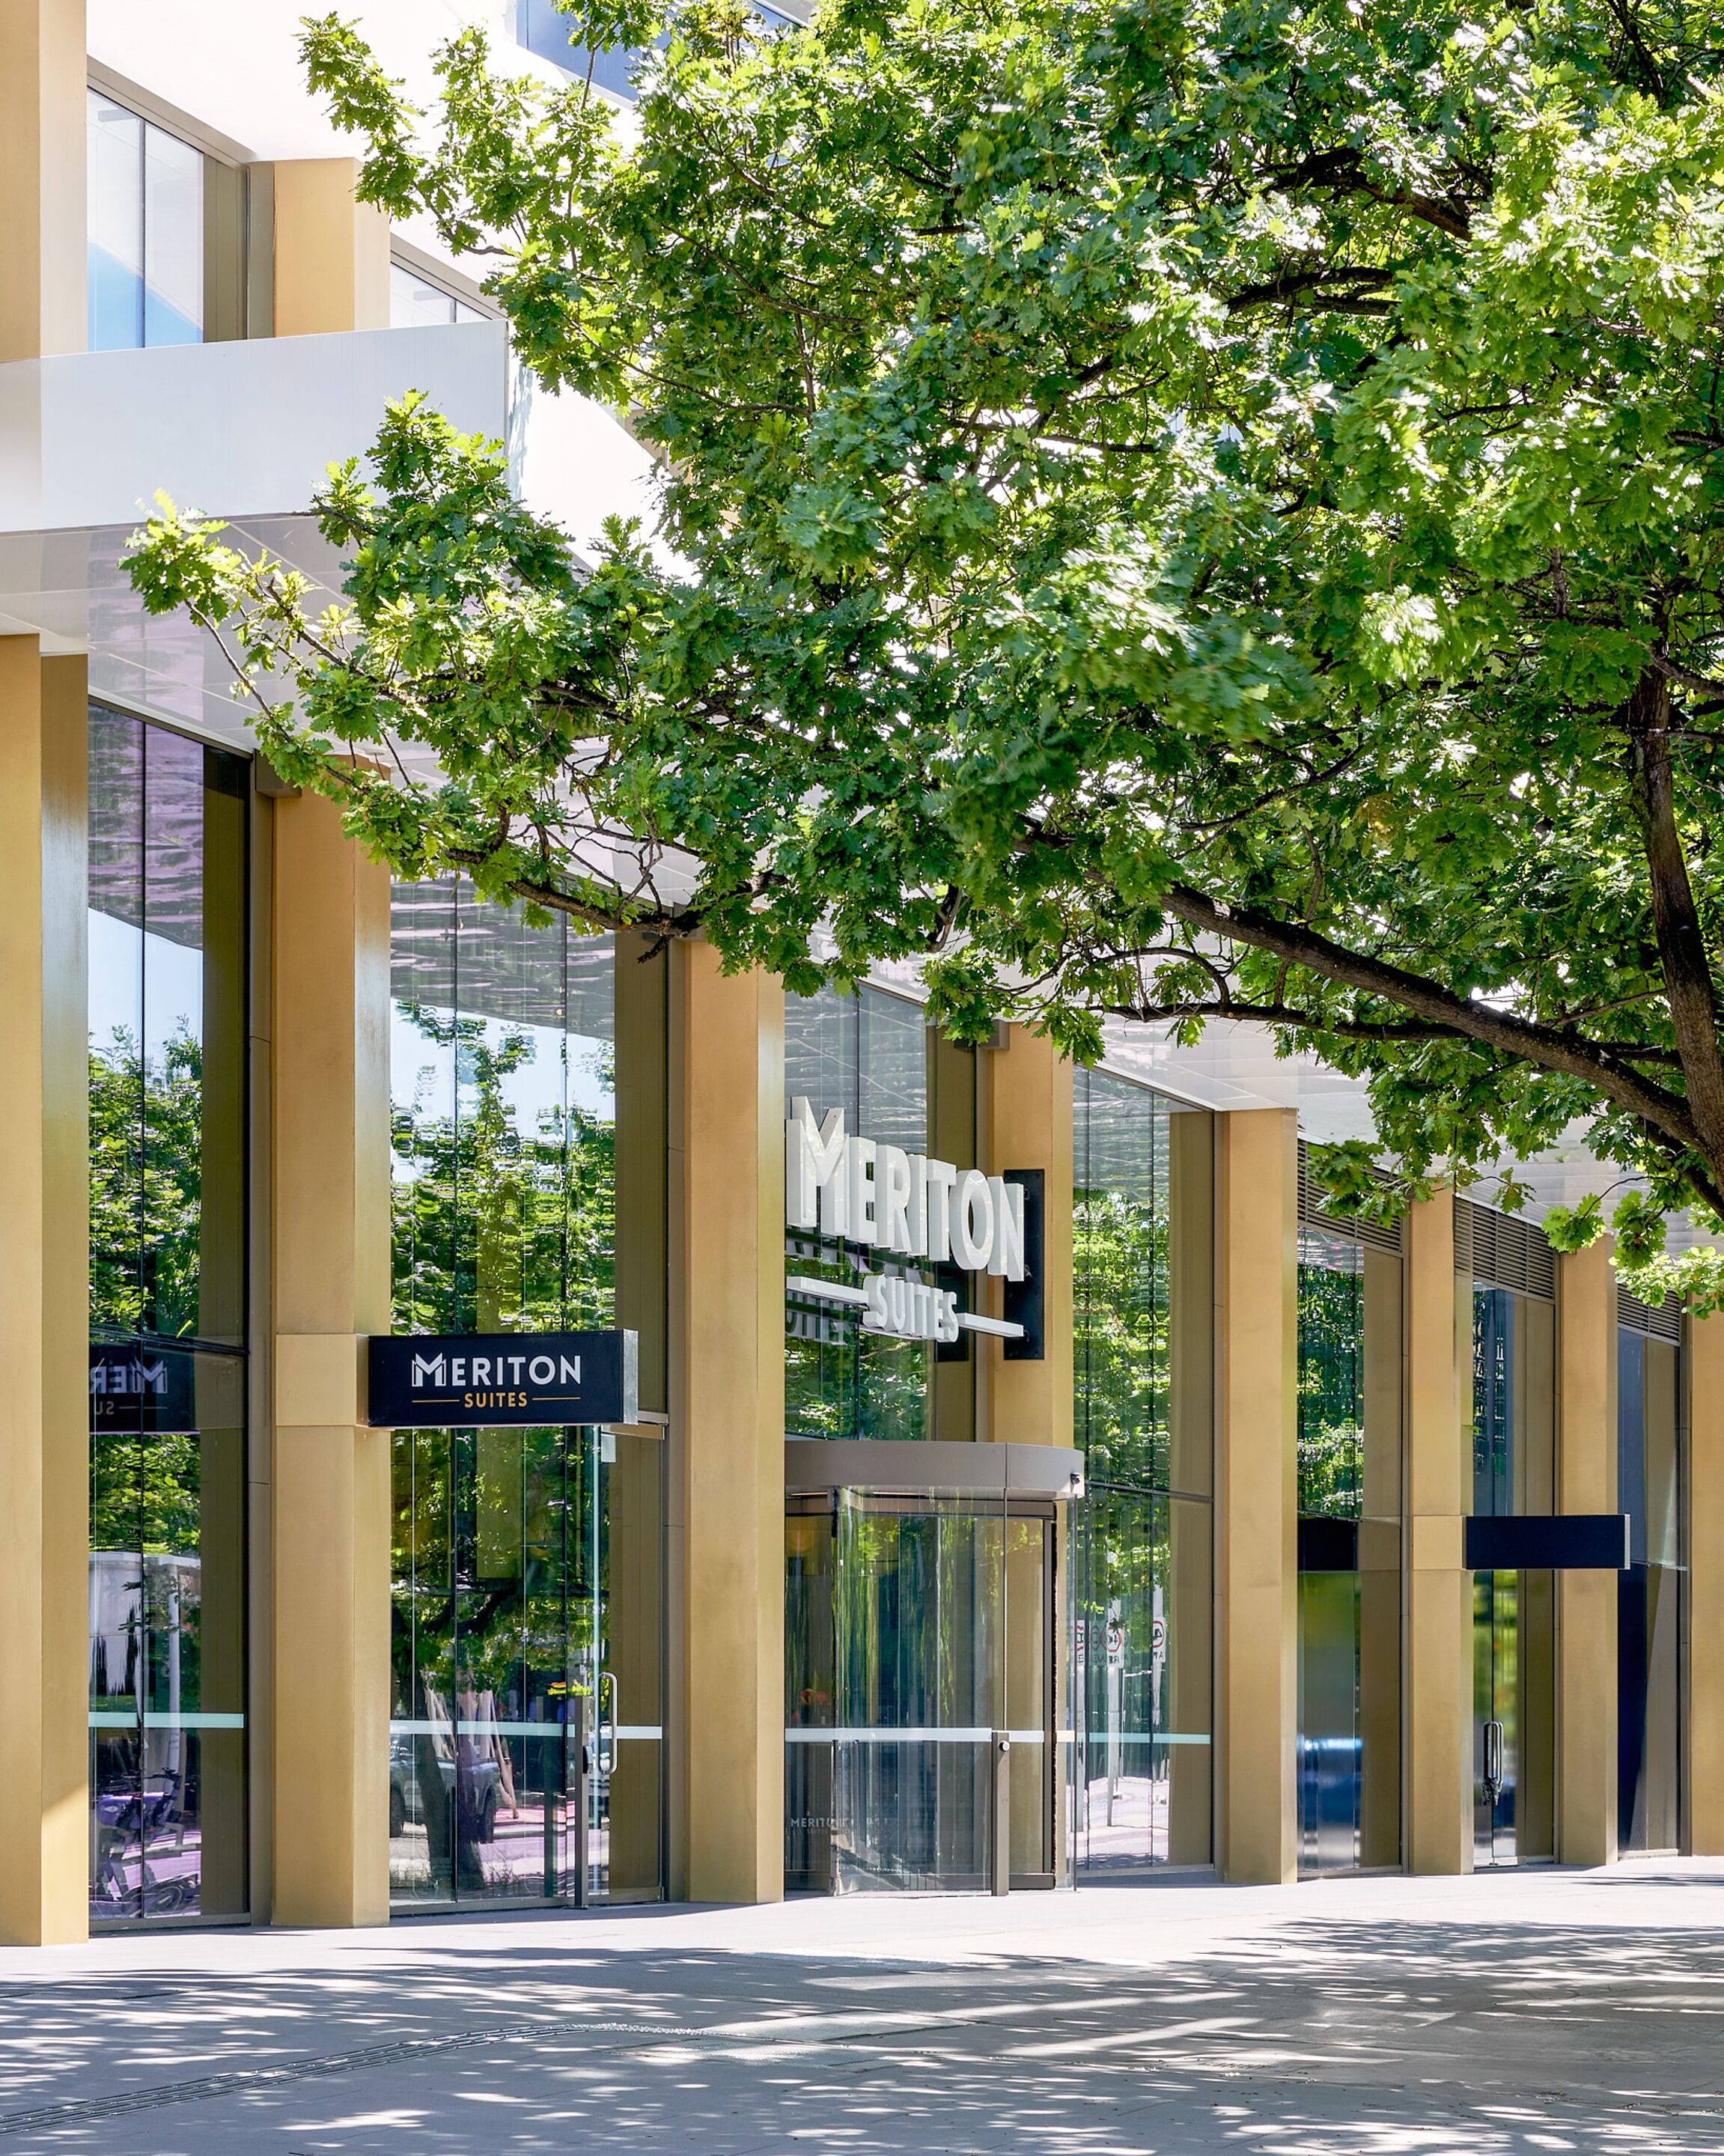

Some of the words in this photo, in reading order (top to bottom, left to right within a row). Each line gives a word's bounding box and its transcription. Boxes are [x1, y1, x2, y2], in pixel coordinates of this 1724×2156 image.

[785, 1096, 1025, 1282] MERITON
[862, 1274, 959, 1342] SUITES
[412, 1352, 581, 1386] MERITON
[464, 1392, 528, 1408] SUITES
